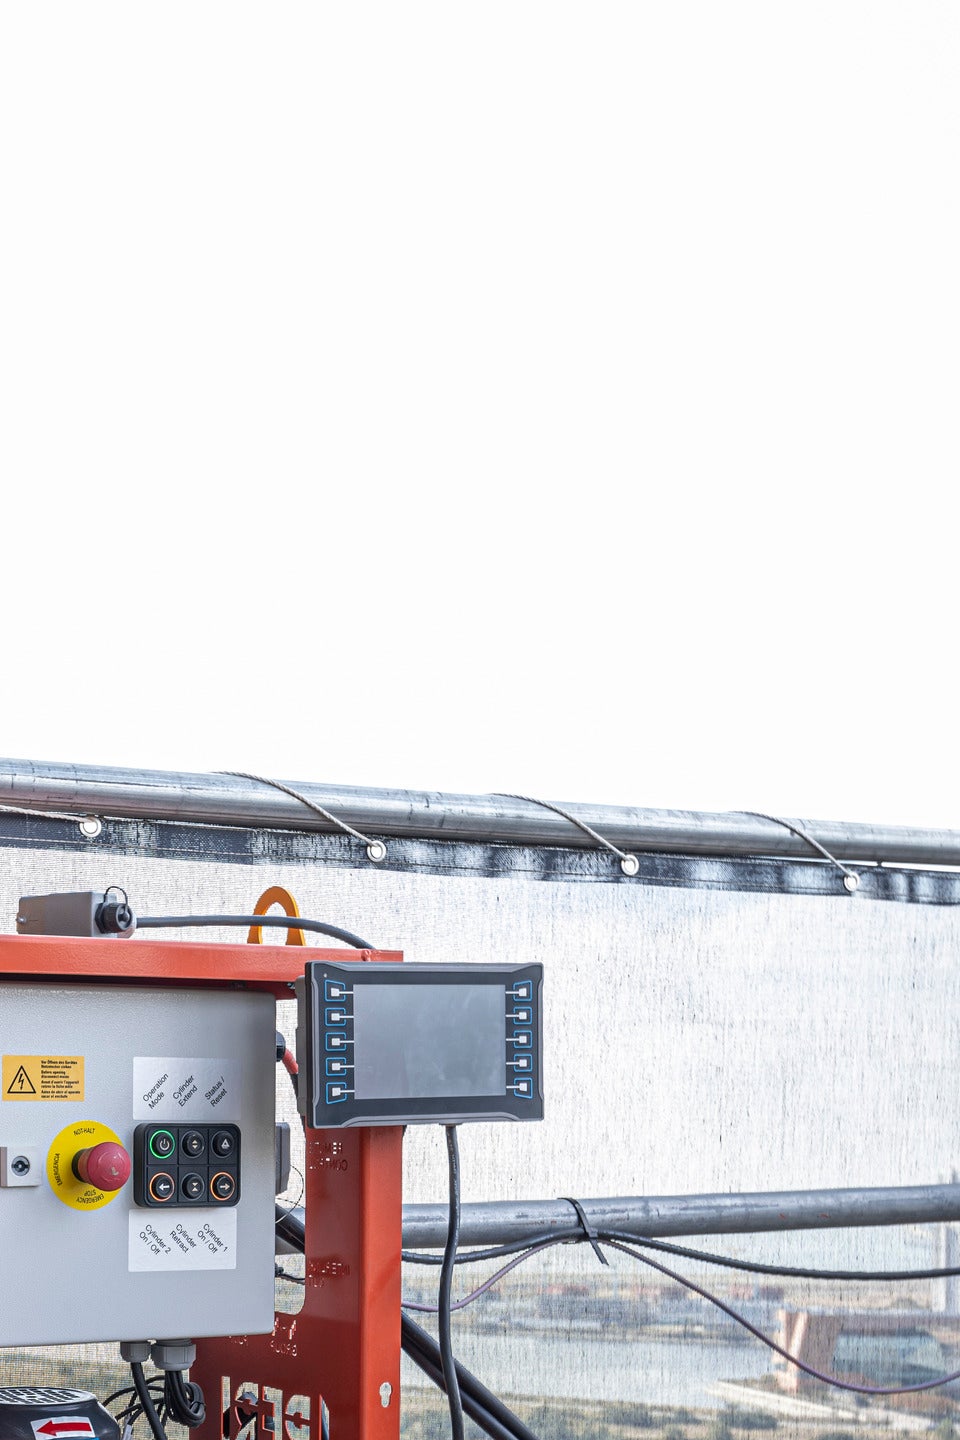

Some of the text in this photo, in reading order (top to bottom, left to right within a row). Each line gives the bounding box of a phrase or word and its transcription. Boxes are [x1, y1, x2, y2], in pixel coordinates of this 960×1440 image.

[142, 1073, 169, 1102] Operation
[172, 1075, 195, 1100] Cylinder
[178, 1085, 198, 1107] Extend
[204, 1081, 223, 1100] Status
[210, 1088, 228, 1107] Reset
[148, 1091, 165, 1109] Mode
[76, 1193, 105, 1204] EMERGENCY
[84, 1189, 97, 1197] STOP
[139, 1231, 148, 1243] On
[150, 1244, 161, 1255] Off
[145, 1224, 172, 1255] Cylinder 2
[169, 1230, 189, 1253] Retract
[175, 1223, 197, 1248] Cylinder
[197, 1230, 206, 1241] On
[208, 1242, 218, 1254] Off
[203, 1223, 224, 1247] Cylinder
